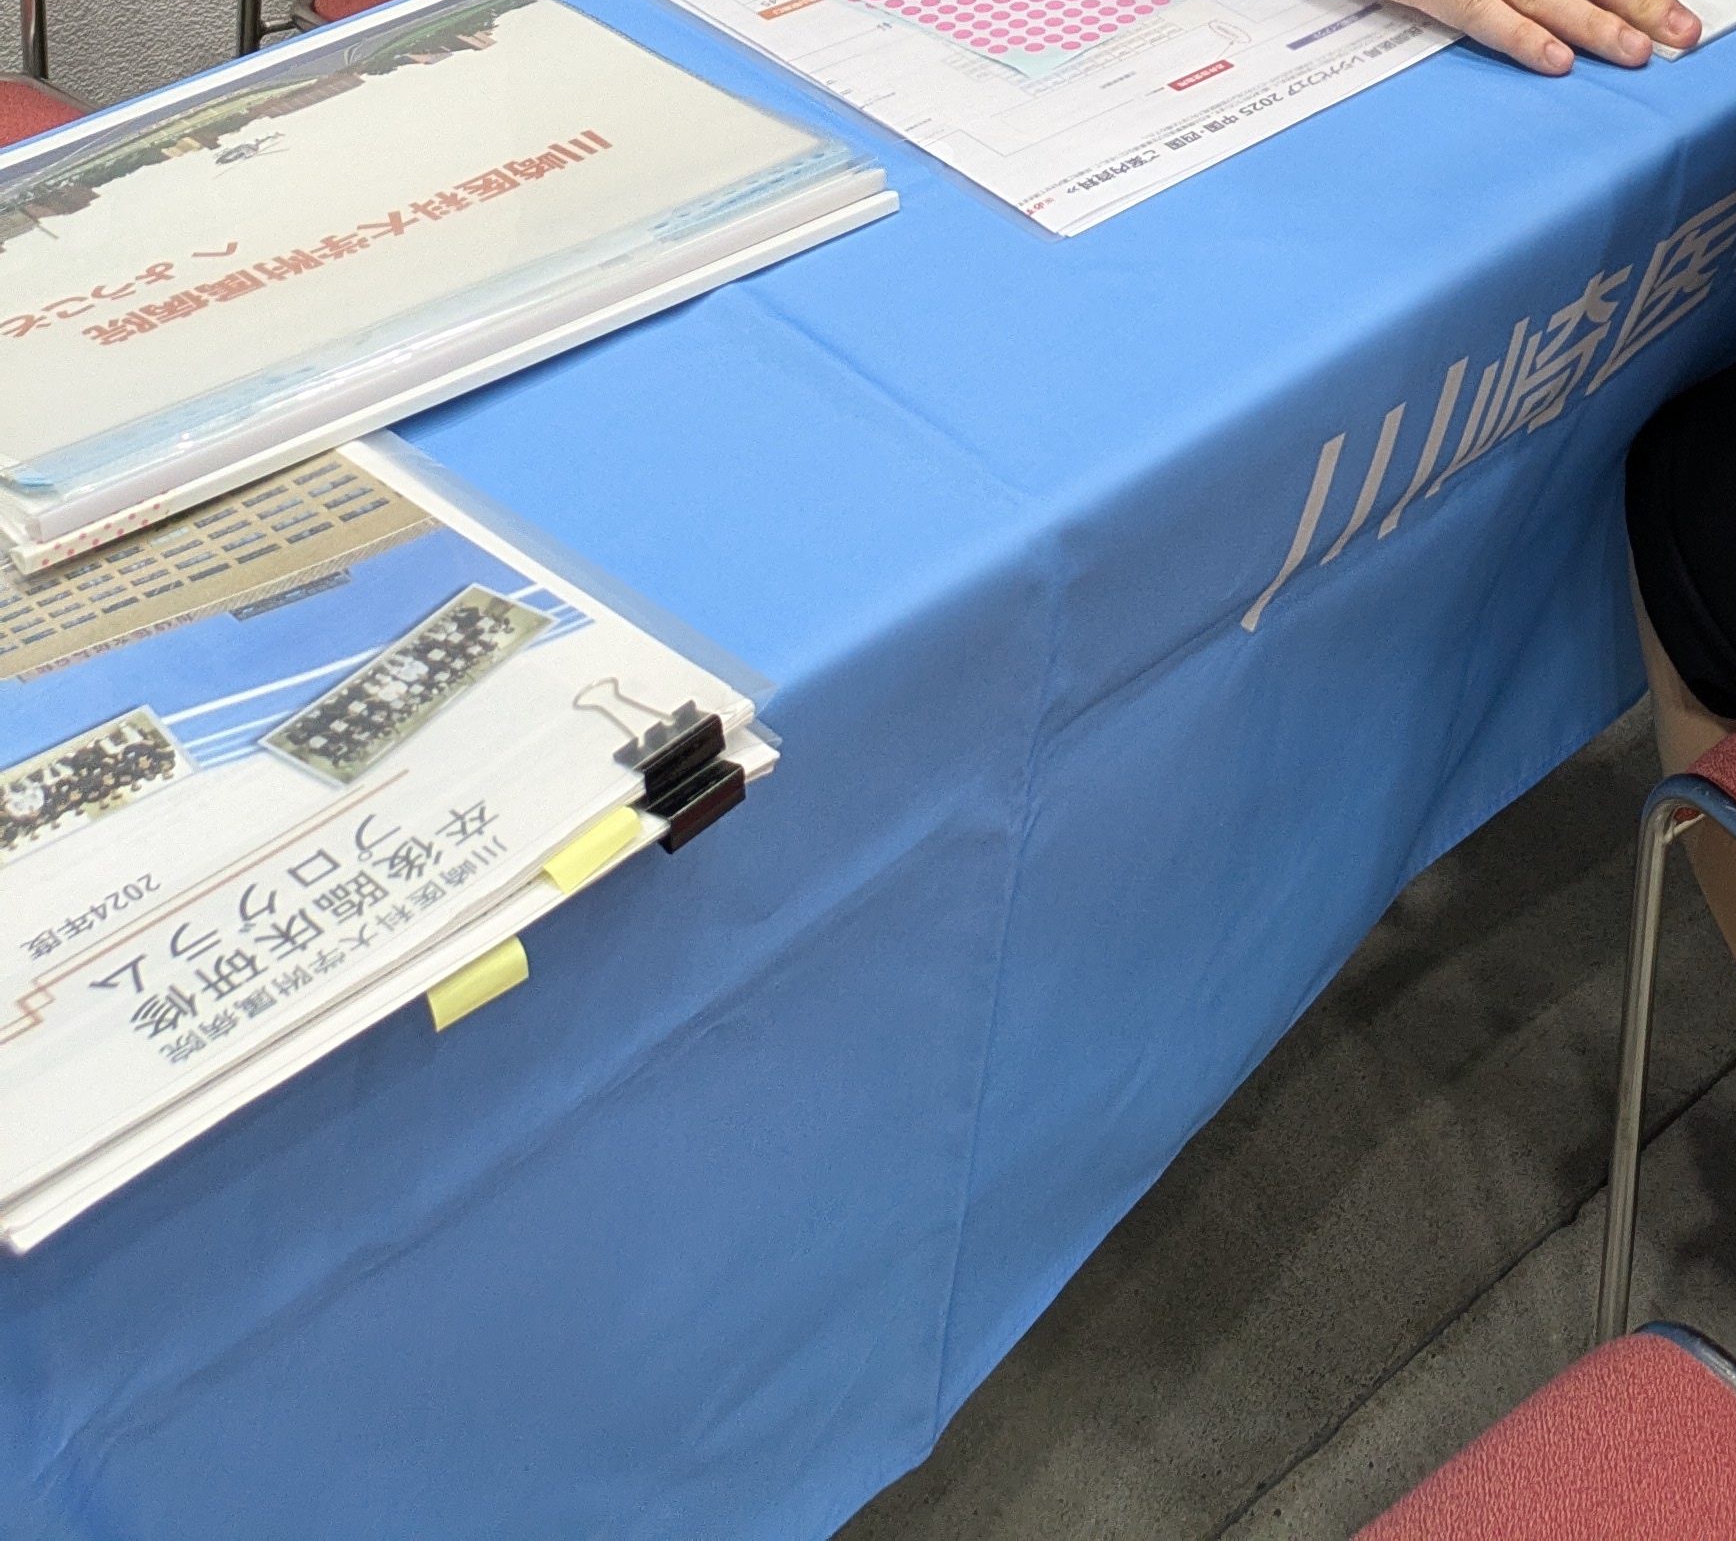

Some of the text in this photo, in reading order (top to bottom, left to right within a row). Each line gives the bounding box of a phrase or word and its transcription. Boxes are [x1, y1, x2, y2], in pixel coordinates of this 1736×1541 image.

[1164, 115, 1239, 152] 中国・四国
[1238, 91, 1284, 117] 2025
[82, 129, 613, 346] 川崎医科大学附属病院
[20, 872, 161, 963] 2024年度
[88, 813, 402, 994] プログラム
[129, 799, 501, 1041] 卒後臨床研修
[159, 835, 508, 1065] 川崎医科大学附属病院
